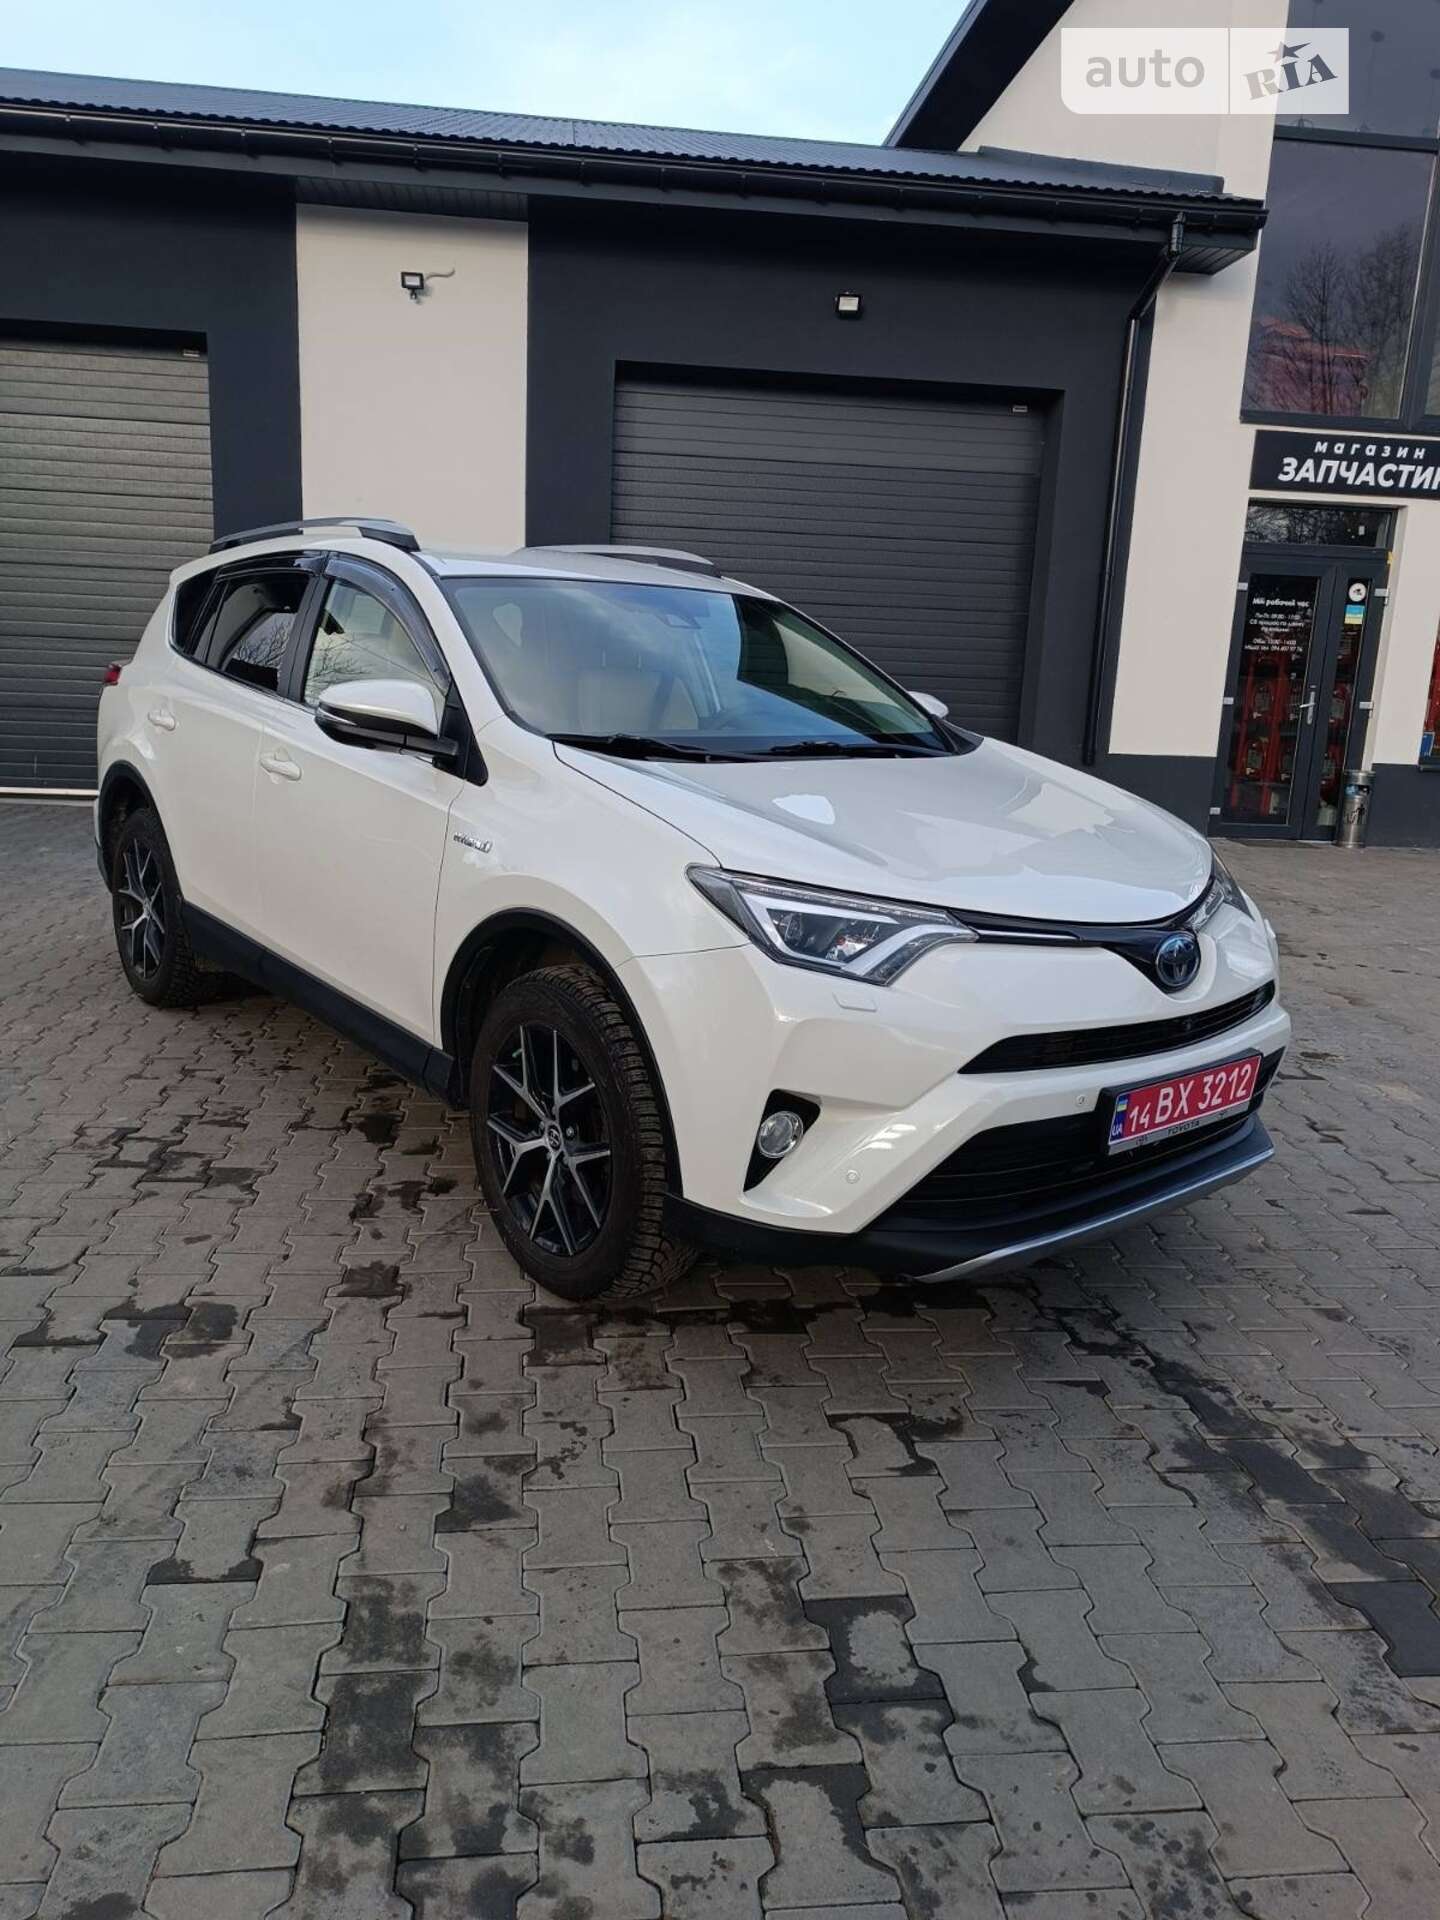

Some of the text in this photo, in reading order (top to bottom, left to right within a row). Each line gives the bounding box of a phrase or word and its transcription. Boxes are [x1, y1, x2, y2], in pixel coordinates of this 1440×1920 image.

[1313, 440, 1426, 460] магазин
[1128, 1063, 1252, 1132] 14 BX 3212
